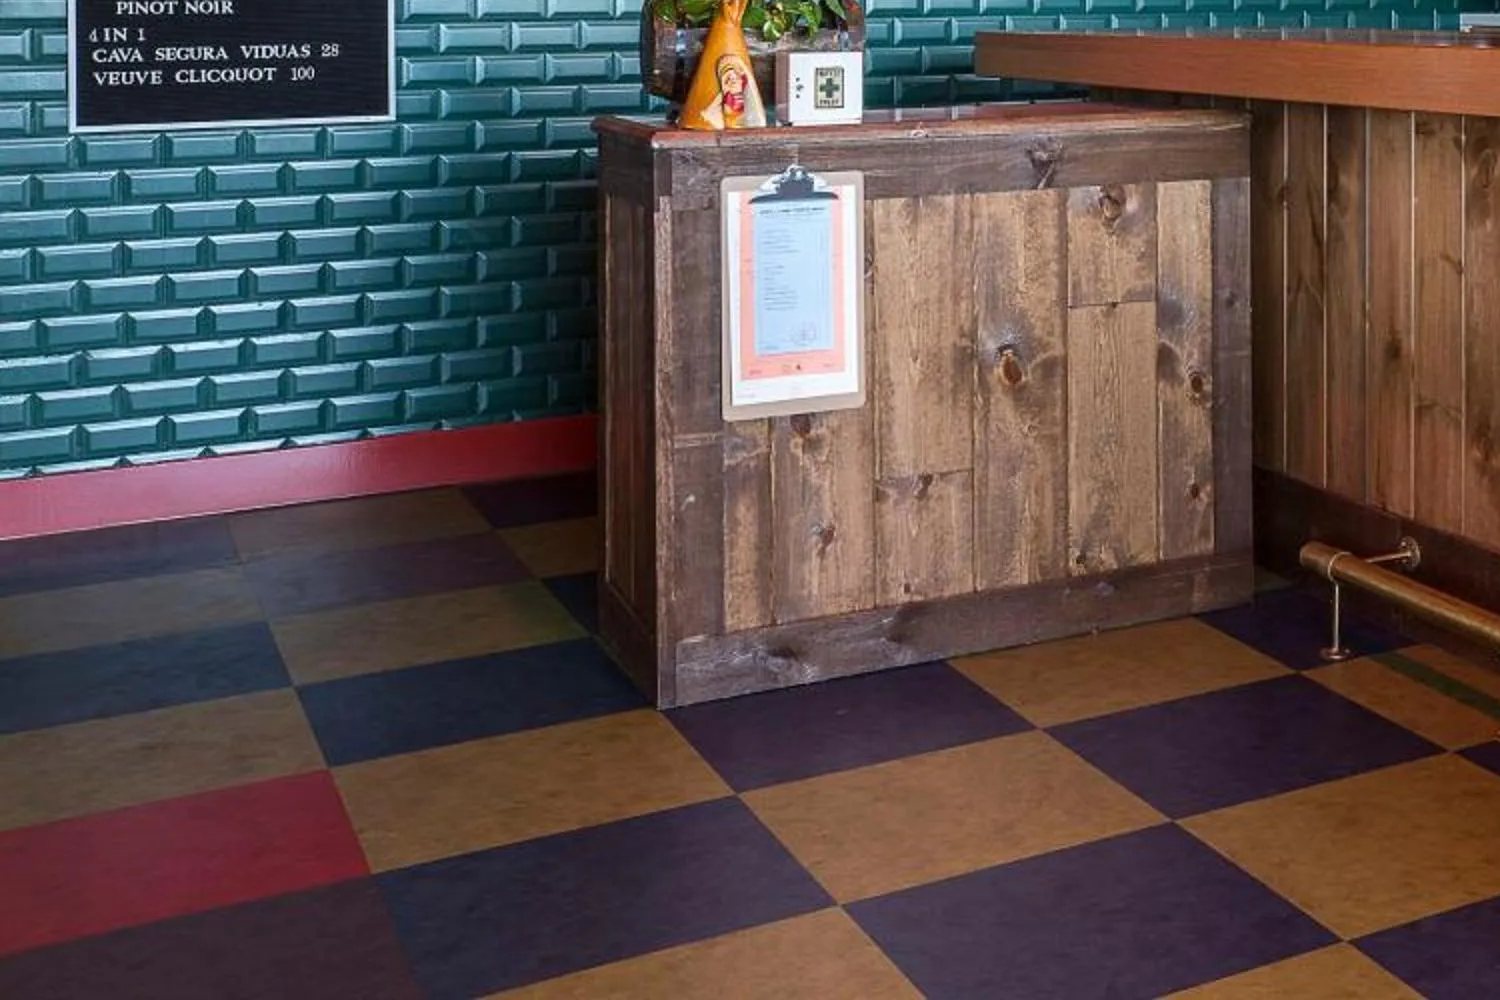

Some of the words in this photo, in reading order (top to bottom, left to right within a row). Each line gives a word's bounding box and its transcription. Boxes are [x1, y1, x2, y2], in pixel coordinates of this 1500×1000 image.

[116, 1, 178, 14] PINOT
[185, 0, 234, 14] NOIR
[104, 28, 127, 41] IN
[137, 28, 146, 41] 1
[92, 49, 143, 63] CAVA
[155, 47, 228, 61] SEGURA
[240, 44, 310, 58] VIDUAS
[321, 44, 339, 57] 28
[94, 72, 162, 86] VEUVE
[175, 68, 276, 83] CLICQUOT
[291, 66, 315, 80] 100
